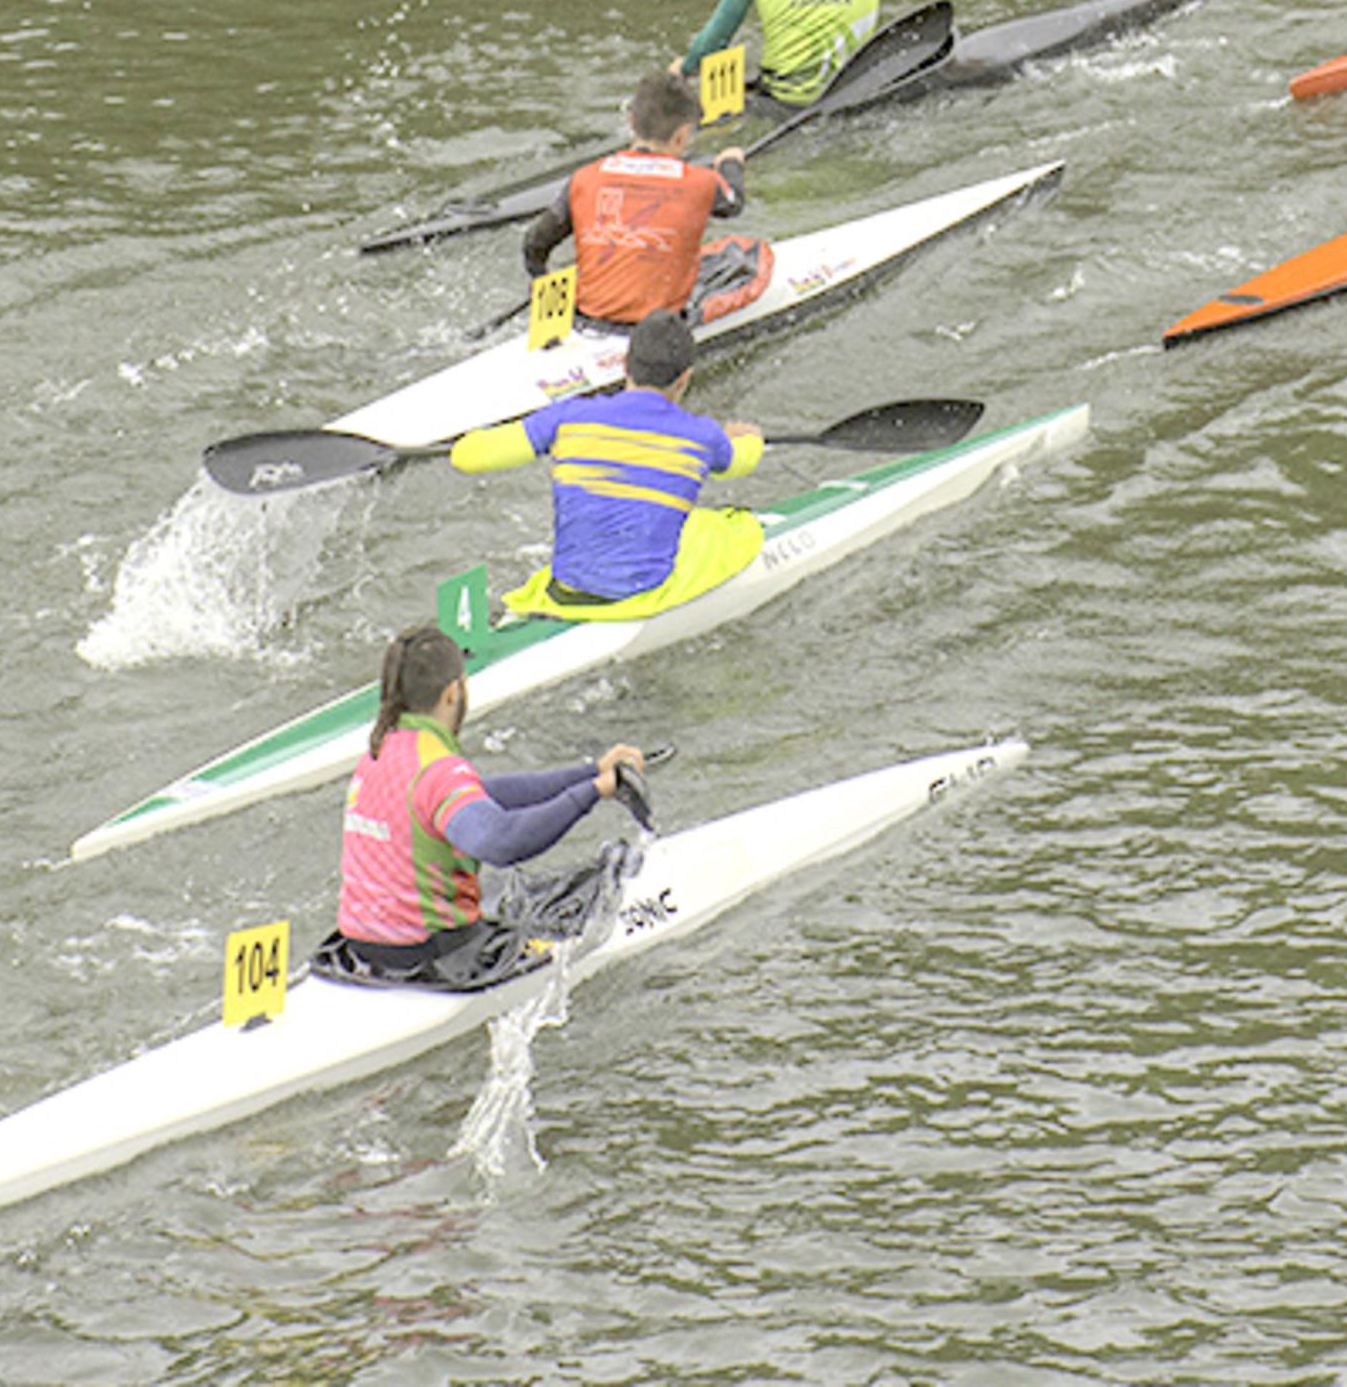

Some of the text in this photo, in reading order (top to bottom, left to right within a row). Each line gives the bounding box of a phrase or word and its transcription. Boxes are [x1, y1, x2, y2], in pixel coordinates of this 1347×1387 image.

[708, 60, 738, 102] 111
[456, 585, 472, 632] 4
[235, 936, 280, 995] 104
